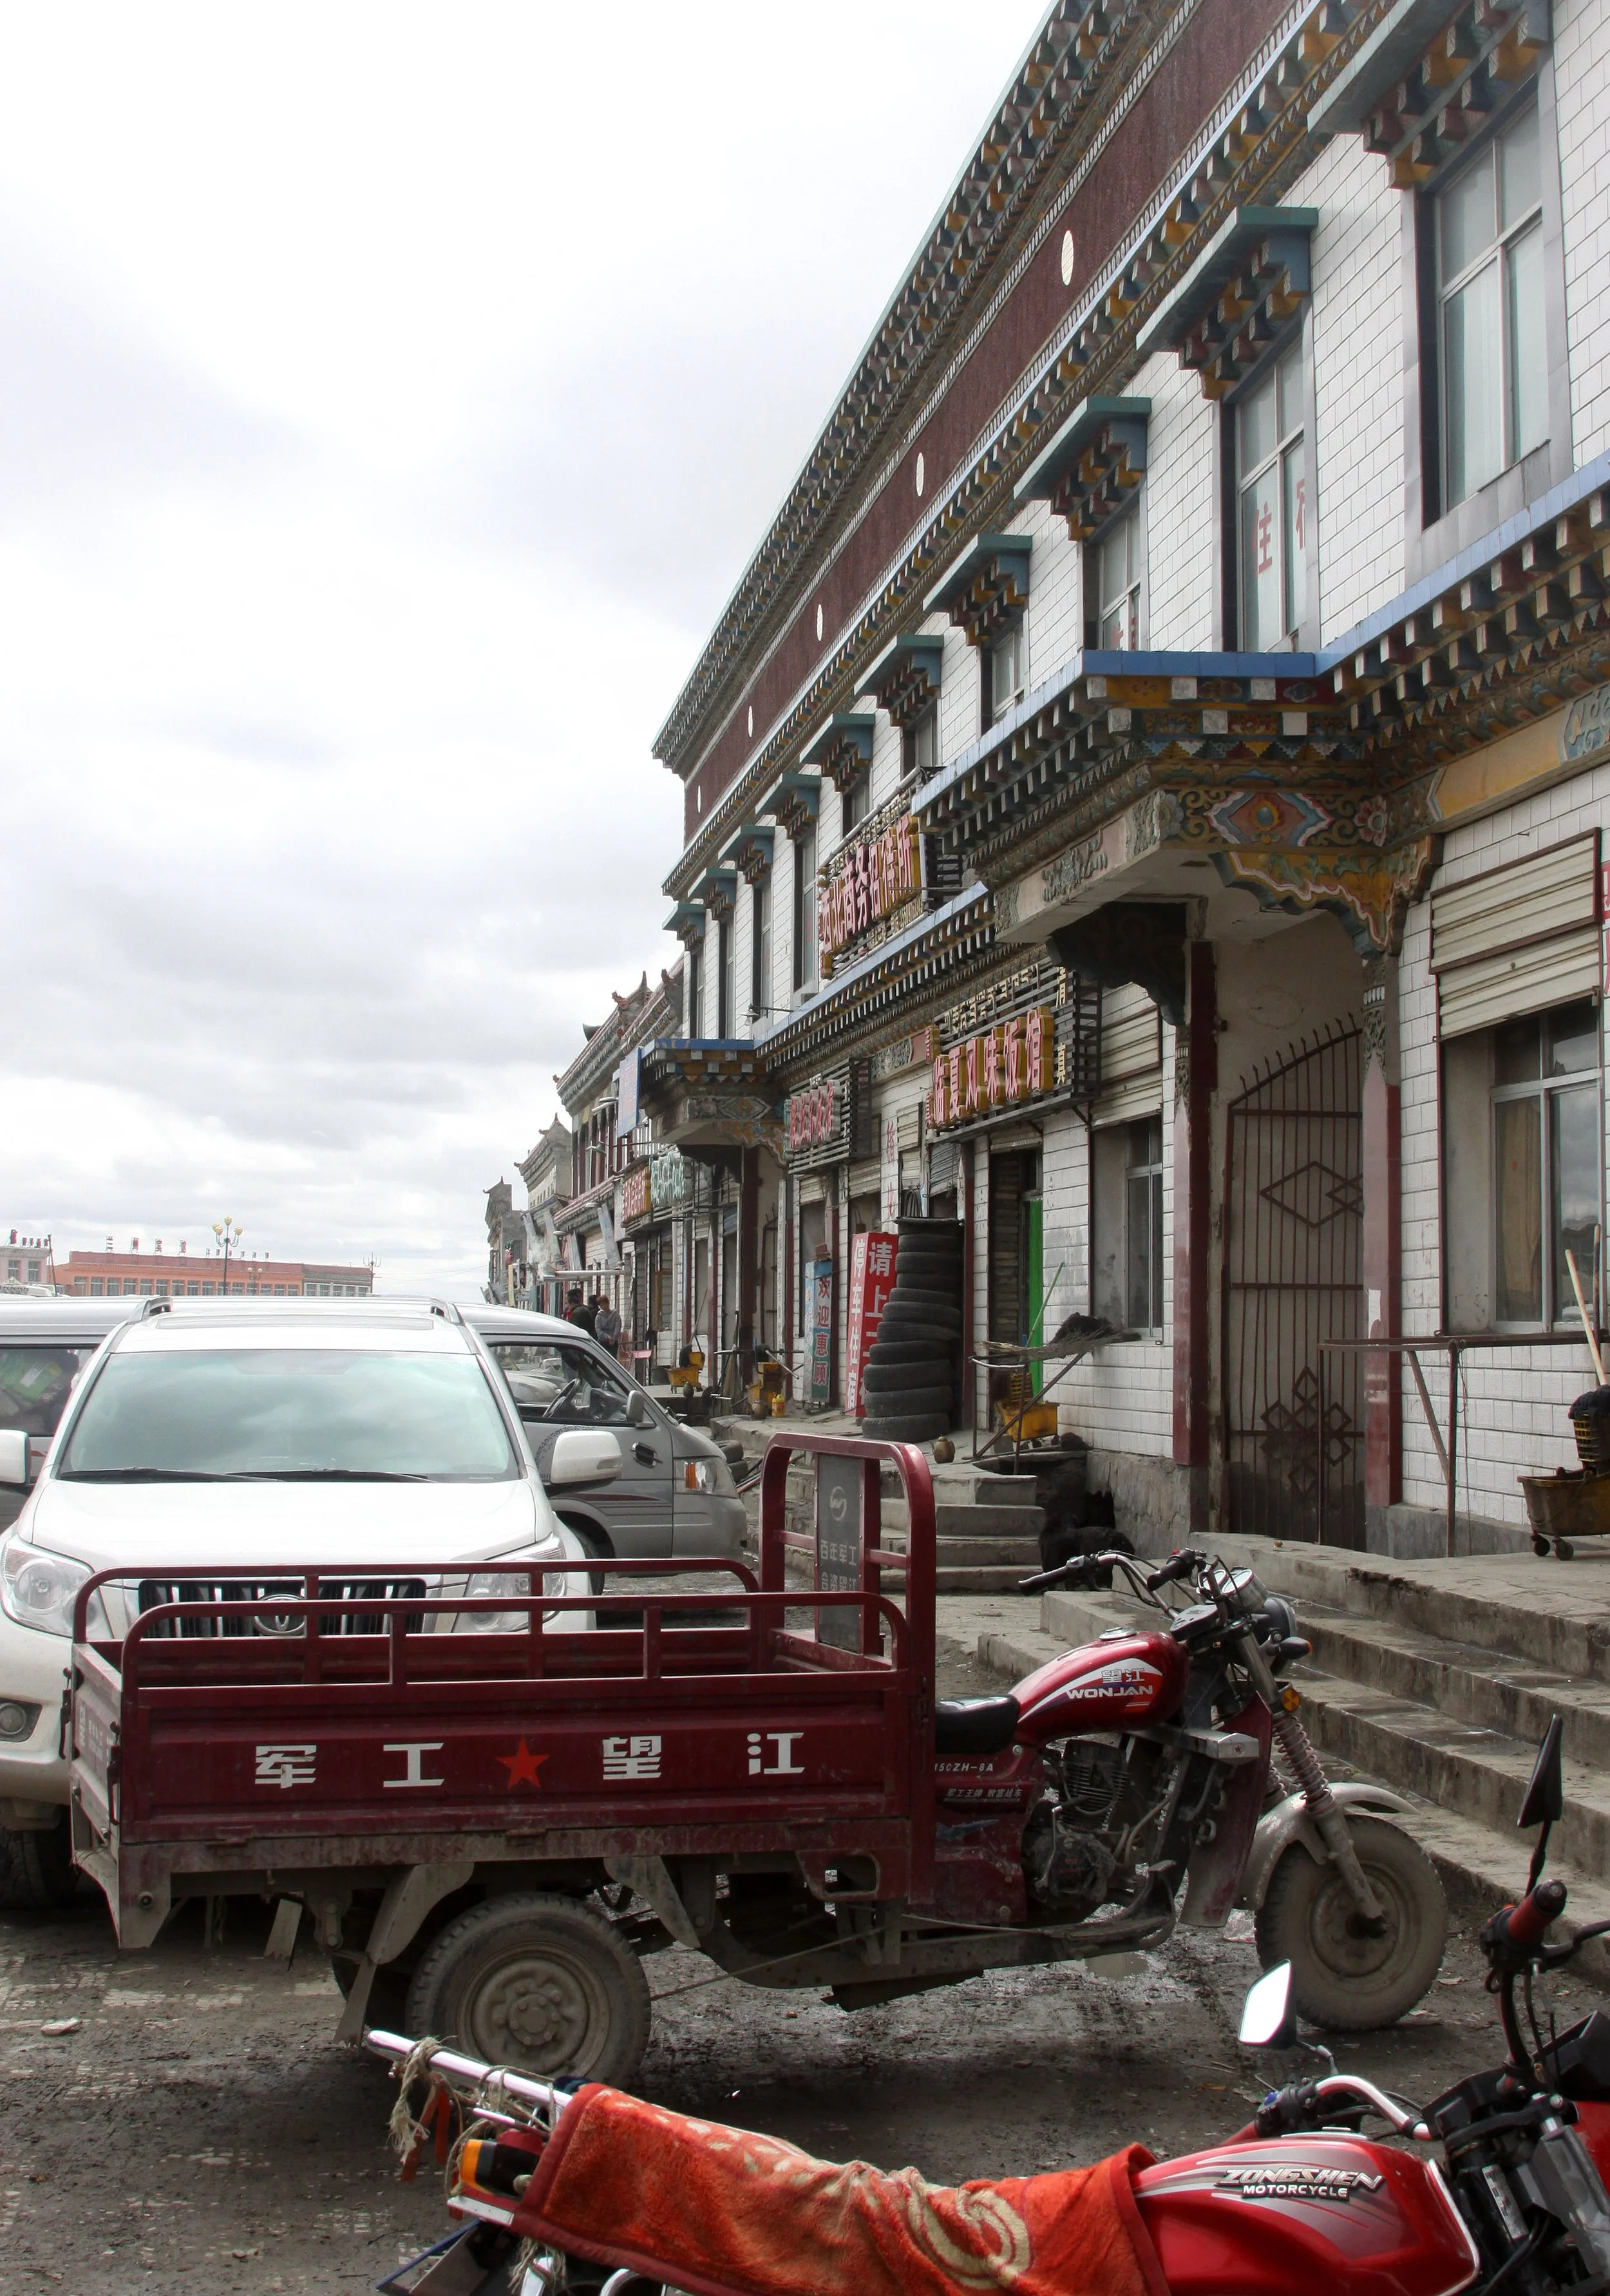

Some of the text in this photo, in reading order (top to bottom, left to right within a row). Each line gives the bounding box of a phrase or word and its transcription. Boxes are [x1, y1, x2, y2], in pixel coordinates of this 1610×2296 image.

[820, 812, 913, 954] 西北商务招待所
[934, 1009, 1045, 1126] 临夏风味饭馆
[812, 1276, 831, 1386] 欢迎惠顾
[847, 1238, 866, 1410] 停车住宿
[1065, 1685, 1153, 1700] WONJAN
[1101, 1668, 1145, 1684] 望江
[1217, 2168, 1385, 2190] ZONGSHEN
[1243, 2184, 1349, 2198] MOTORCYCLE
